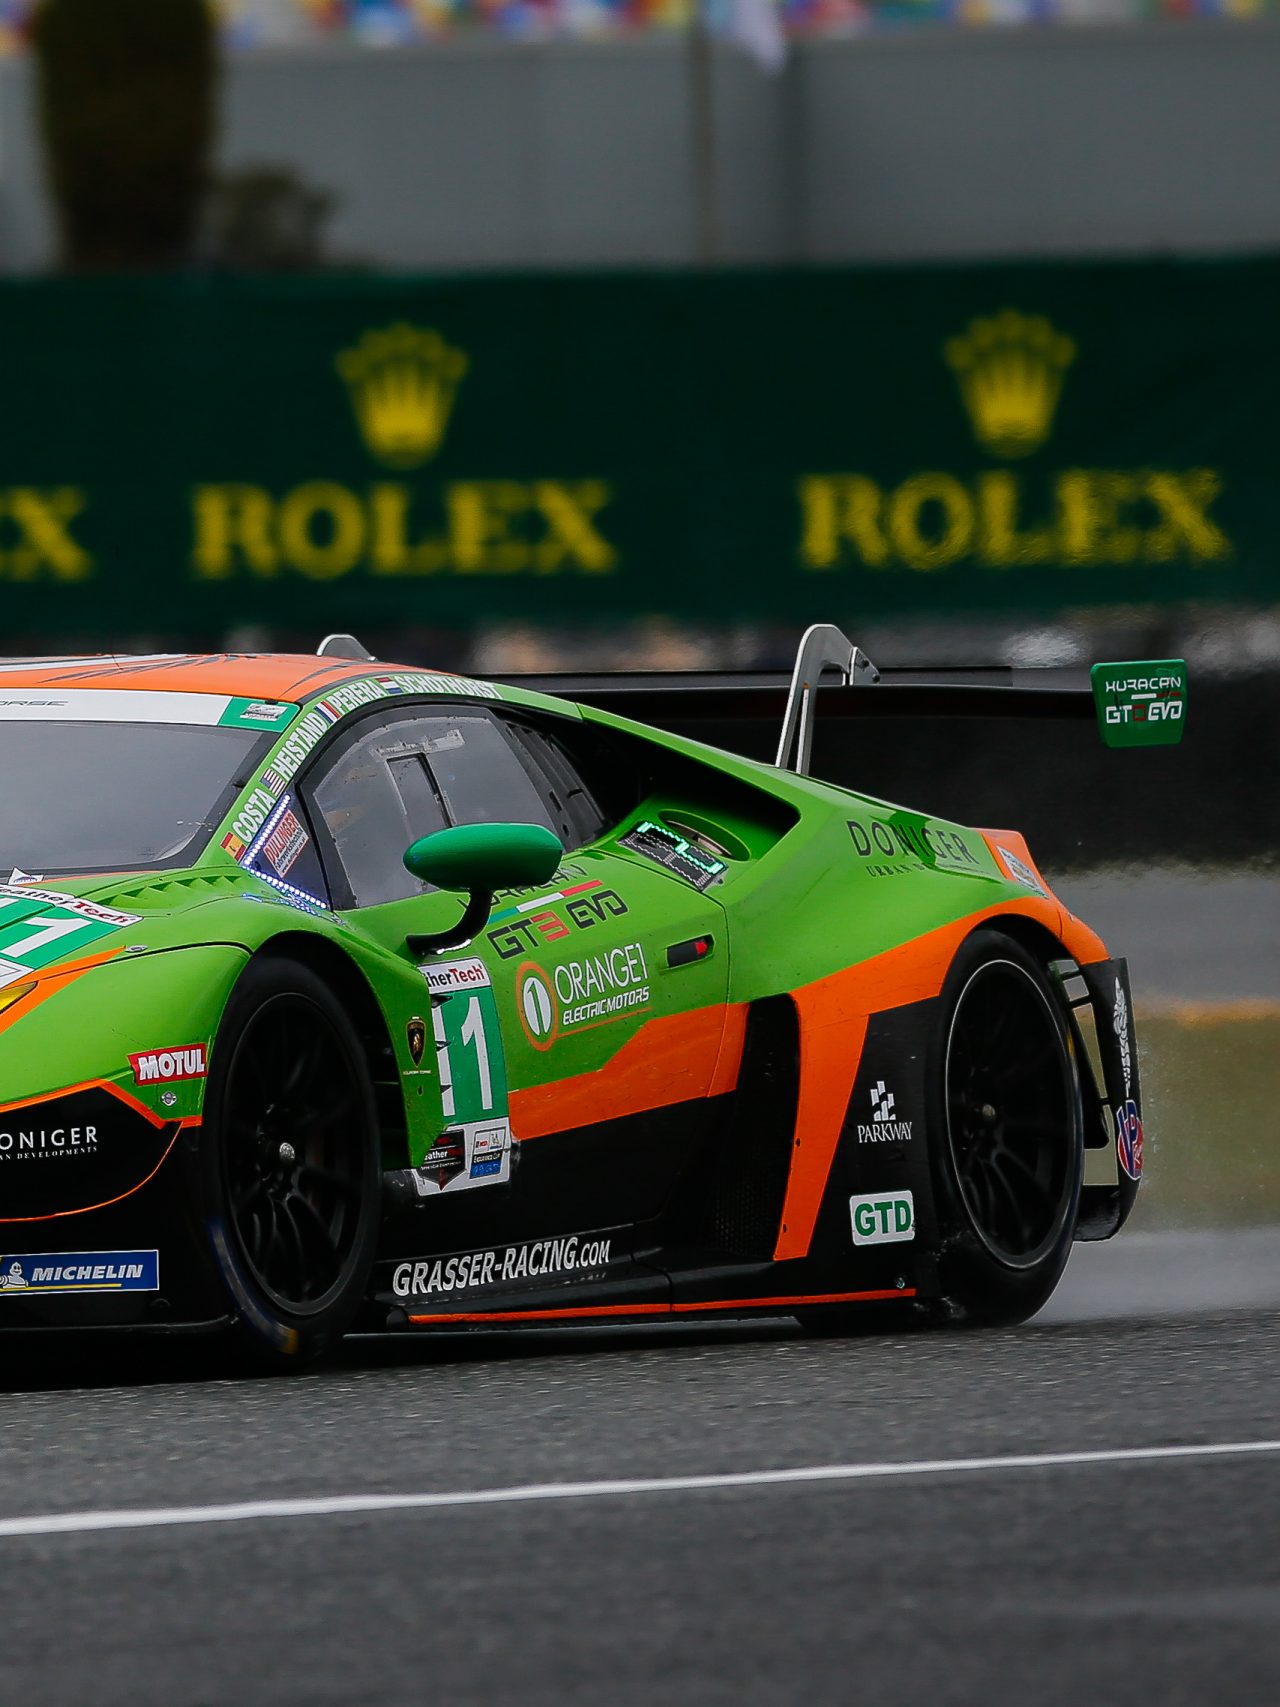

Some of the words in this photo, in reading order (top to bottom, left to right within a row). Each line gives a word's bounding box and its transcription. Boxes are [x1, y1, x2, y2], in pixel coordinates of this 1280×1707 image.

[193, 479, 615, 580] ROLEX
[798, 468, 1229, 571] ROLEX
[1105, 676, 1182, 692] HURACAN
[1148, 700, 1183, 720] EVO
[232, 787, 277, 842] COSTA
[270, 712, 329, 781] HEISTAND
[326, 679, 389, 716] PERERA
[394, 675, 505, 700] SCHOTHORST
[264, 812, 300, 864] DULLINGER
[846, 819, 980, 865] DONIGER
[865, 863, 912, 879] URBAN
[486, 911, 570, 960] GT3
[565, 889, 630, 930] EVO
[554, 942, 648, 1004] ORANGE1
[137, 1047, 206, 1081] MOTUL
[857, 1121, 913, 1144] PARKWAY
[17, 1146, 98, 1160] DEVELOPMENTS
[853, 1199, 912, 1237] GTD
[31, 1264, 144, 1282] MICHELIN
